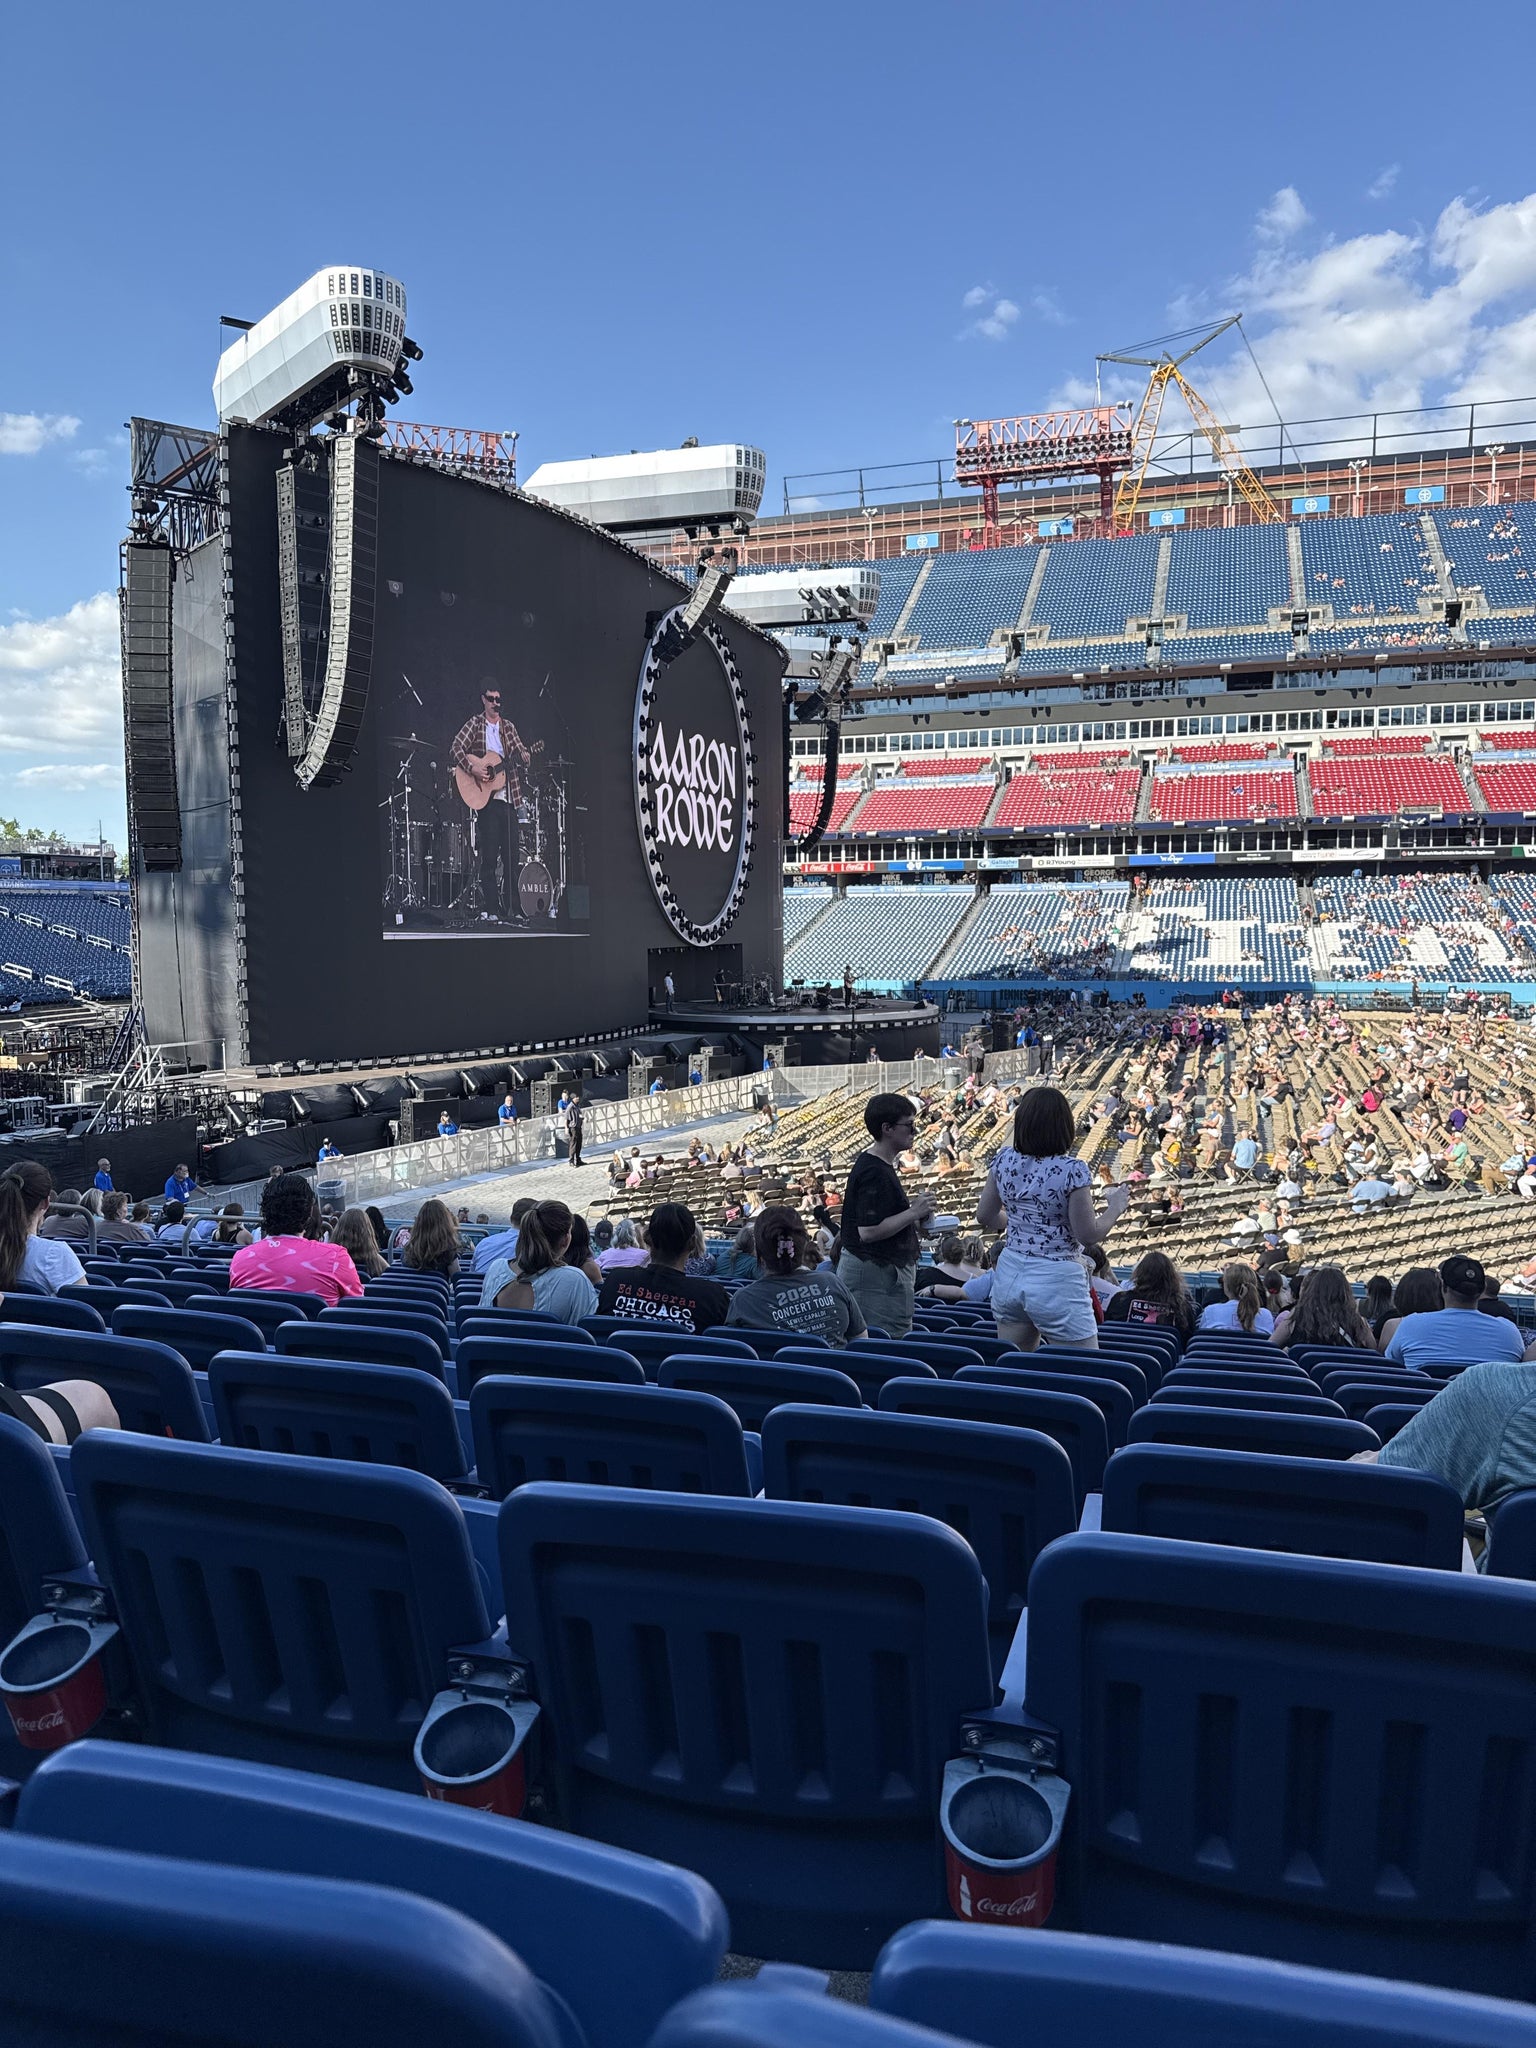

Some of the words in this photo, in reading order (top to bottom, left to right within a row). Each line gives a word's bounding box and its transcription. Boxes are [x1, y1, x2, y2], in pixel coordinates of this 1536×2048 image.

[650, 721, 737, 799] AARON
[655, 783, 734, 853] ROWE
[522, 883, 548, 893] AMBLE
[615, 1295, 692, 1320] CHICAGO
[617, 1283, 632, 1296] Ed
[636, 1286, 696, 1309] Sheeran
[776, 1284, 822, 1307] 2026
[772, 1301, 812, 1322] CONCERT
[813, 1295, 836, 1309] TOUR
[786, 1316, 804, 1326] LEWIS
[804, 1310, 827, 1321] CAPALDI
[977, 1892, 1039, 1916] Coca-Cola
